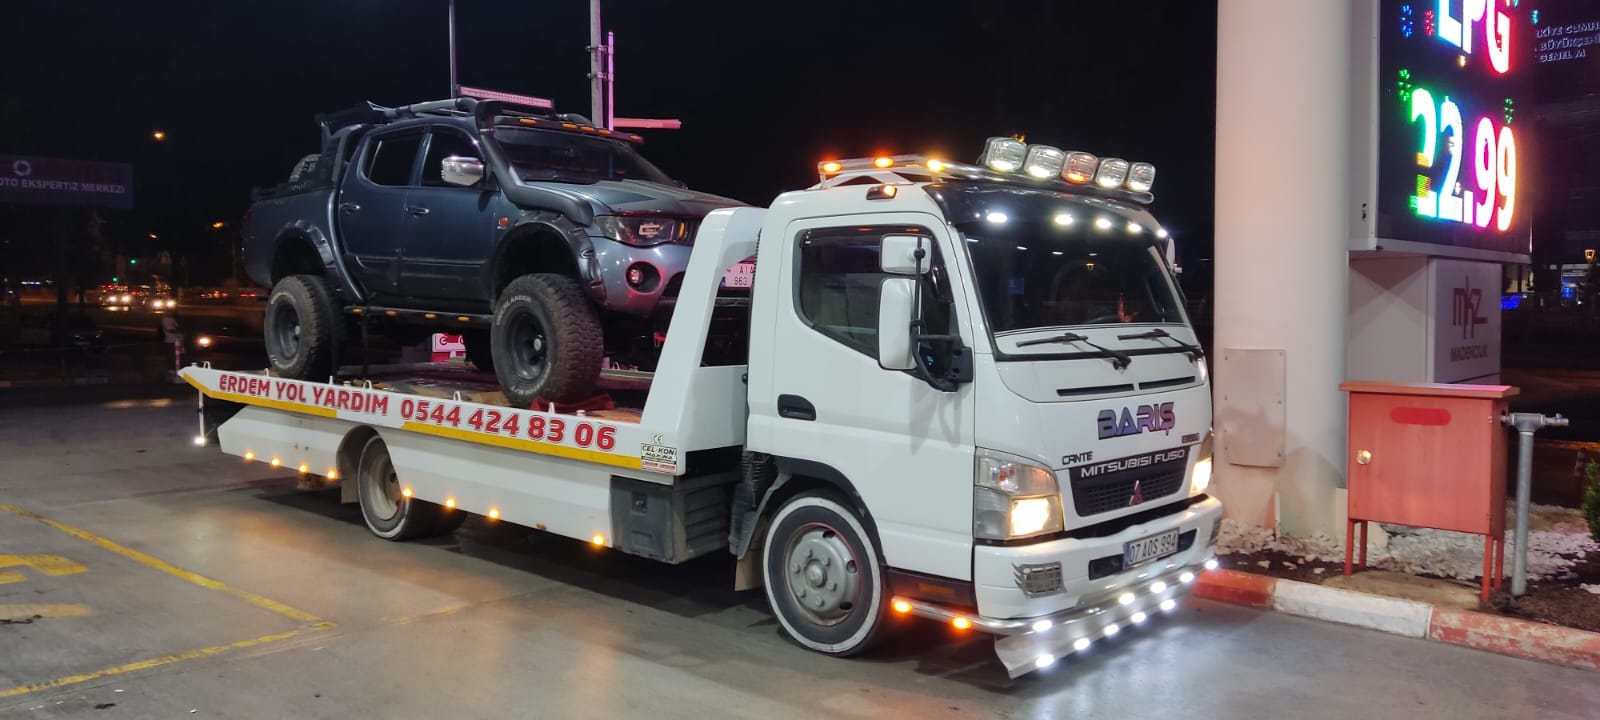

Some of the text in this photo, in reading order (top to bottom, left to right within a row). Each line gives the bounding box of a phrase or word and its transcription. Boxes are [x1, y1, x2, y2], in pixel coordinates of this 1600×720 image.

[1410, 88, 1516, 231] 22.99
[219, 374, 616, 450] ERDEM YOL YARDIM 0544 424 83 06
[1098, 402, 1176, 440] BARIŞ
[1154, 449, 1185, 462] FUSO
[1130, 543, 1141, 562] 07
[1161, 532, 1177, 552] 994
